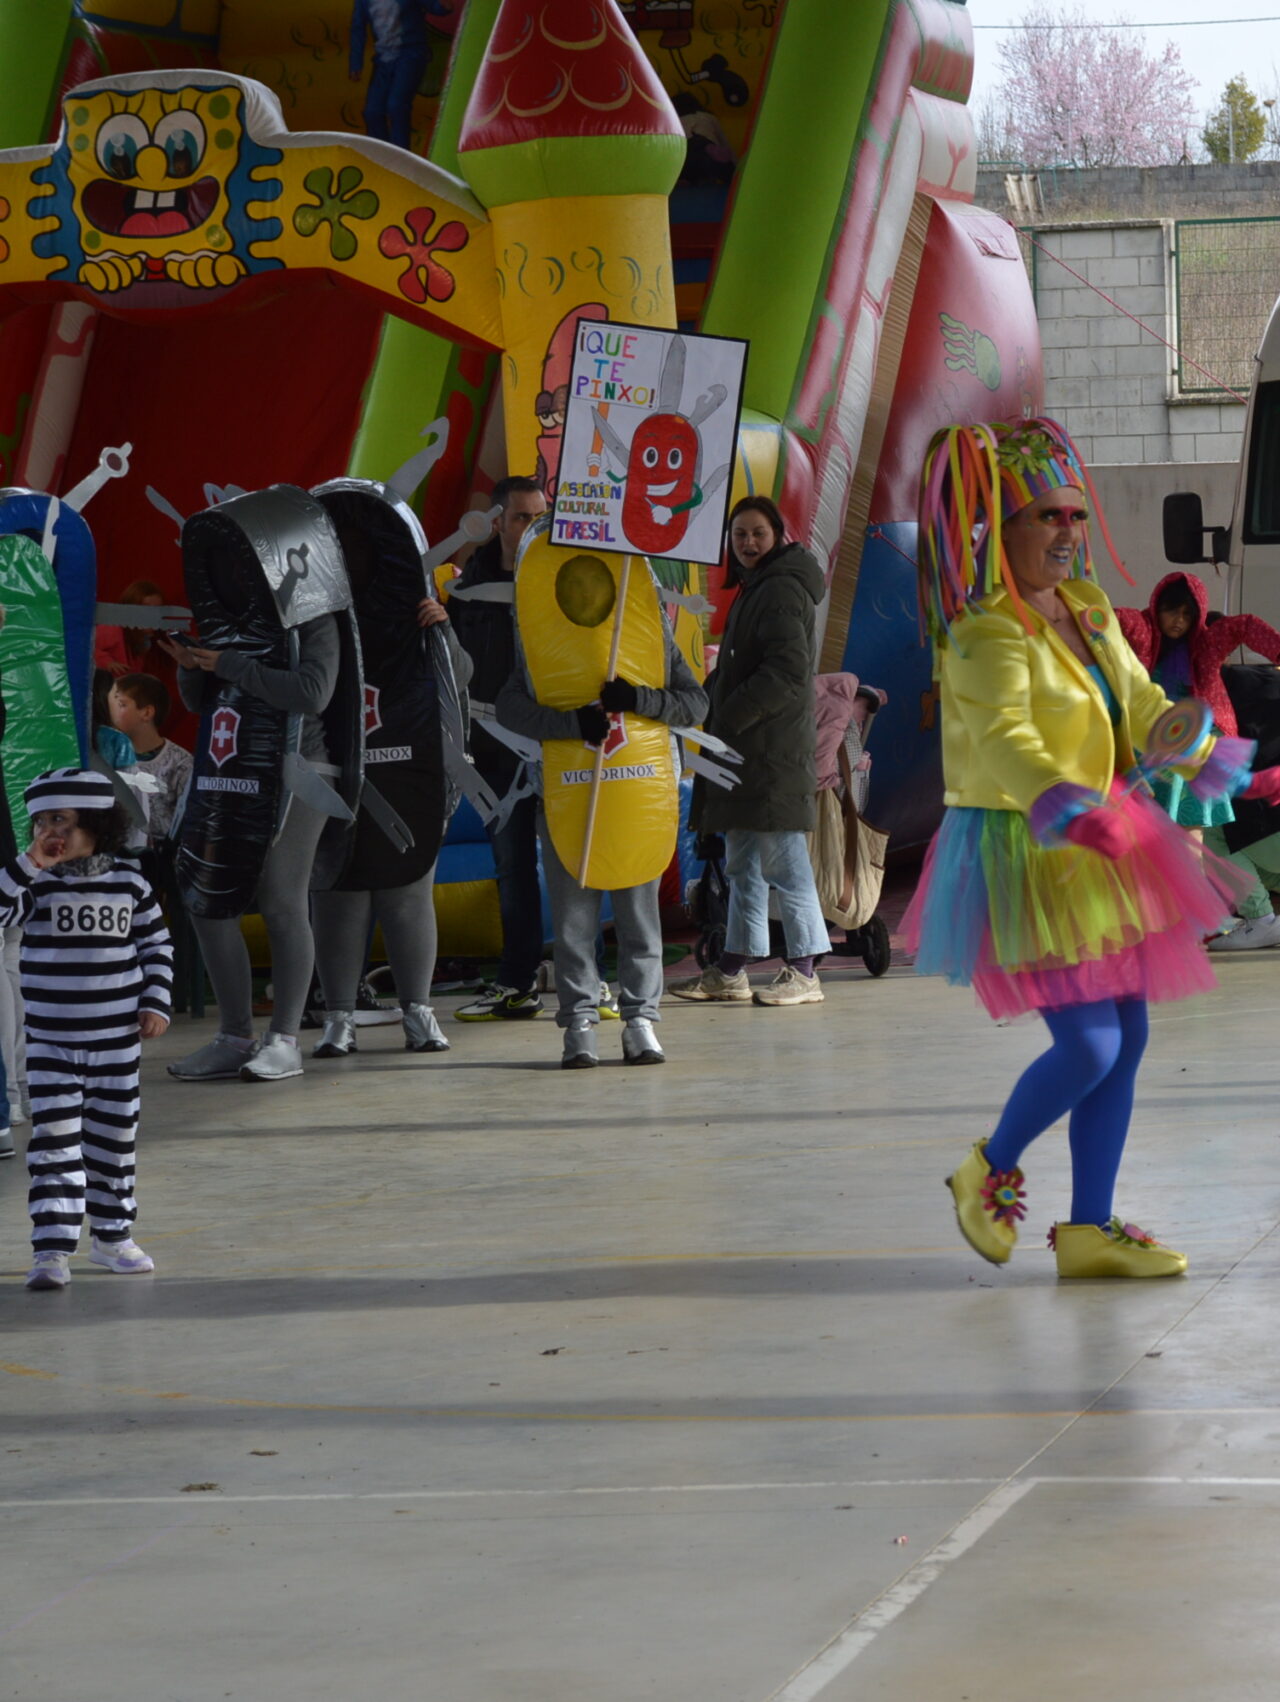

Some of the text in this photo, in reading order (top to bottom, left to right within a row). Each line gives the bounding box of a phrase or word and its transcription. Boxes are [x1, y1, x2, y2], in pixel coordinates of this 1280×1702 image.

[579, 326, 638, 360] ¡QUE
[593, 358, 626, 383] TE
[575, 375, 656, 409] PINXO!
[556, 500, 610, 516] CULTURAL
[57, 905, 129, 932] 8686
